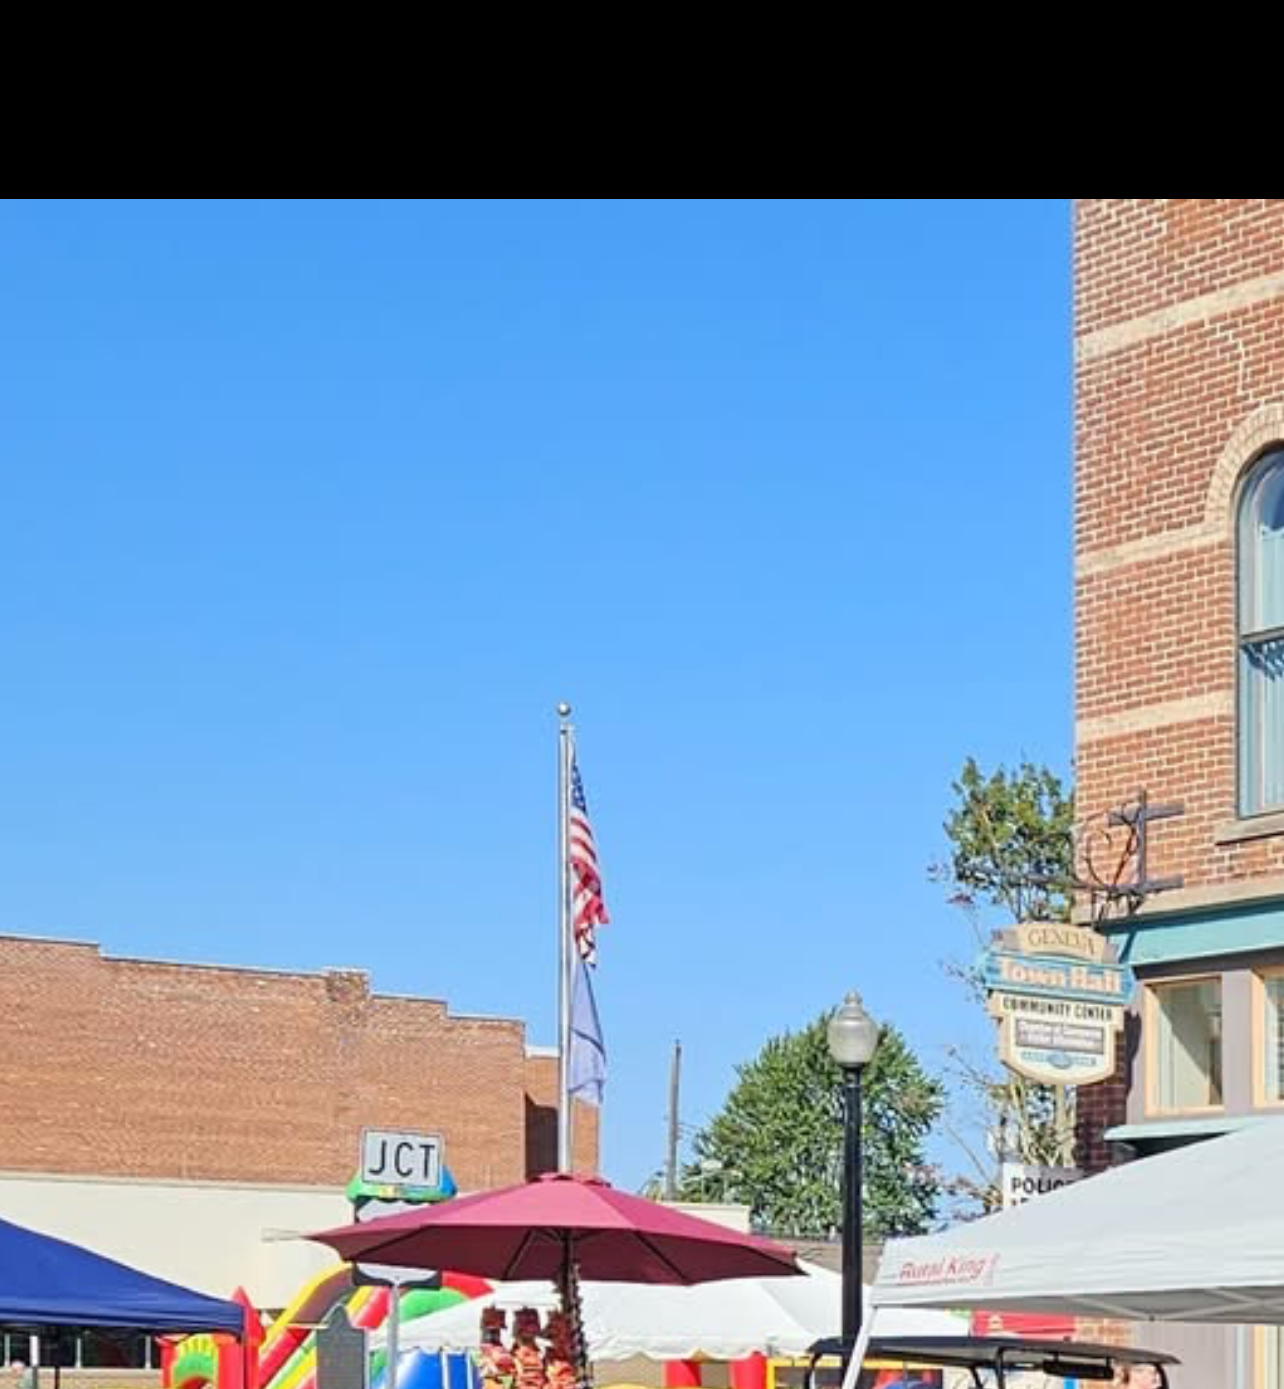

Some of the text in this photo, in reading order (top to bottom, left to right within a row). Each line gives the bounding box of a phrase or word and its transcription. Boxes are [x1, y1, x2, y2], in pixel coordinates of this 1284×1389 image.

[1028, 928, 1096, 956] GENEVA
[1002, 957, 1121, 993] Town Hall
[1003, 997, 1113, 1021] COMMUNITY CENTER
[368, 1139, 436, 1180] JCT
[1011, 1177, 1076, 1194] POLIC
[900, 1252, 987, 1281] Rural King
